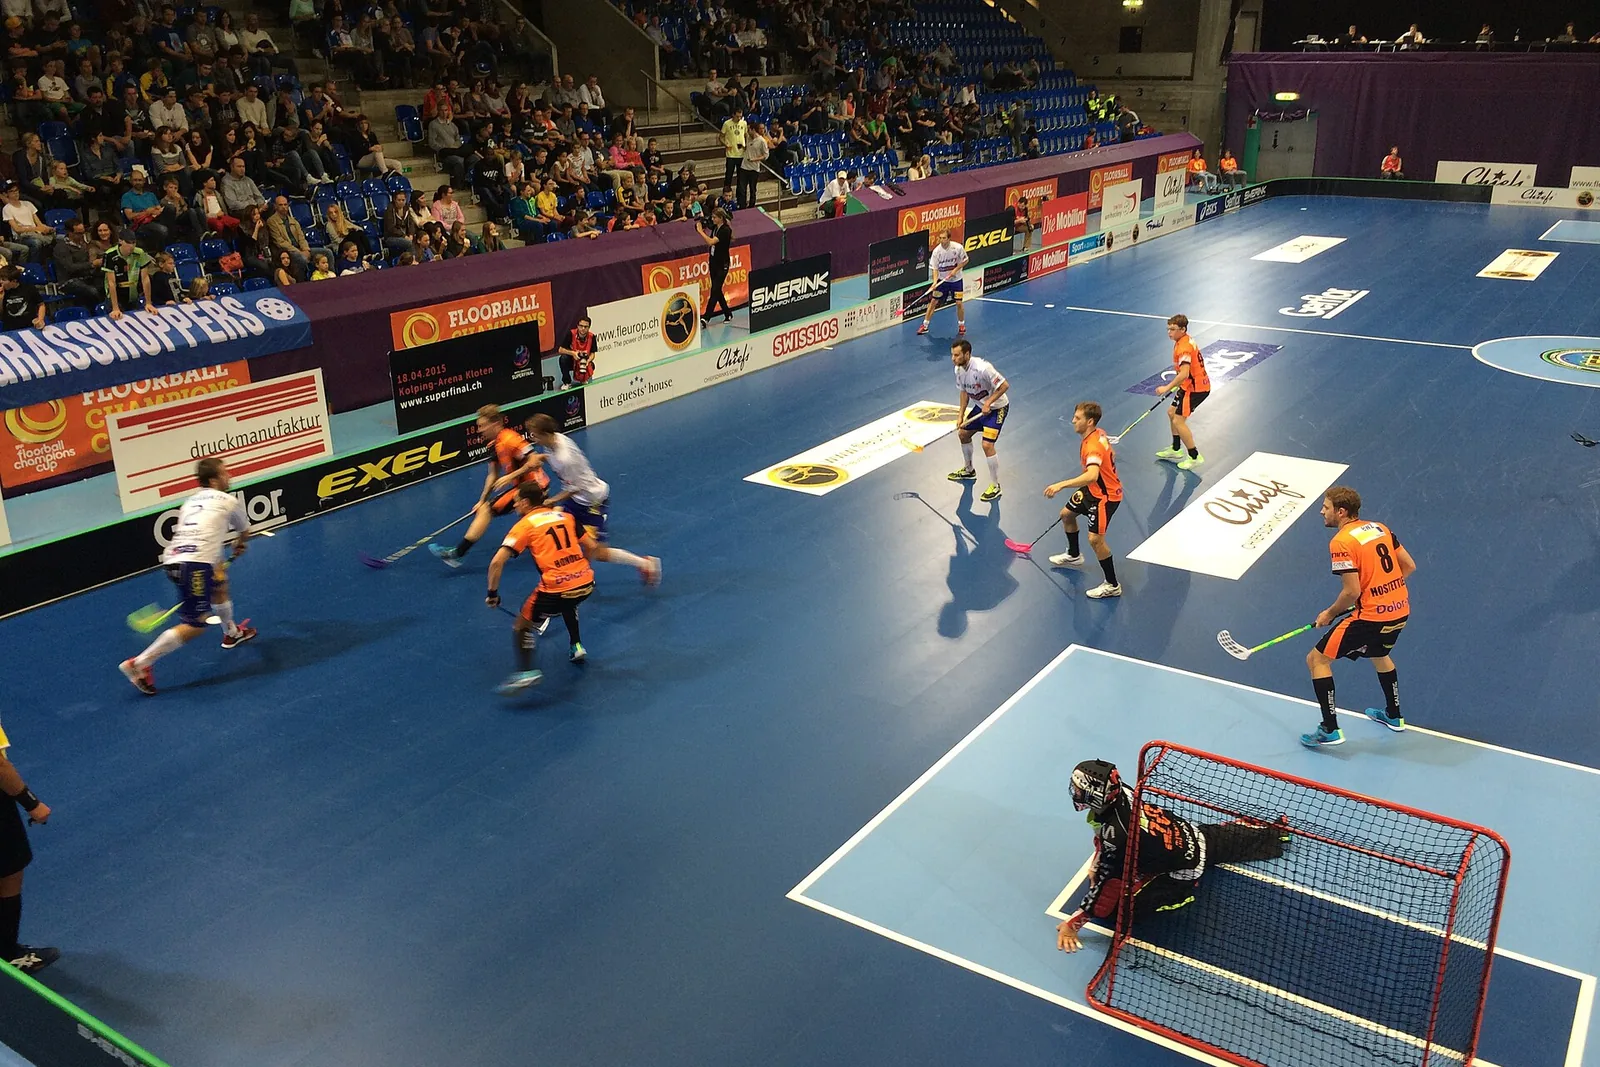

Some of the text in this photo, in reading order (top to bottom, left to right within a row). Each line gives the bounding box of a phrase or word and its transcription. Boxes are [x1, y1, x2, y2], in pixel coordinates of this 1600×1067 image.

[1092, 55, 1100, 66] 5
[1115, 66, 1122, 75] 4
[1136, 87, 1143, 97] 3
[1160, 101, 1167, 112] 2
[1181, 116, 1187, 126] 1
[921, 204, 961, 223] FLOORBALL
[1042, 208, 1087, 235] Die Mobiliar
[964, 227, 1013, 253] EXEL
[1071, 241, 1084, 253] Sport
[1030, 249, 1068, 273] Die Mobiliar
[751, 271, 829, 308] SWERINK
[448, 294, 540, 328] FLOORBALL
[858, 304, 877, 317] PLOT
[773, 317, 839, 357] SWISSLOS
[716, 343, 750, 372] Chiefs
[397, 363, 447, 385] 18.04.2015
[398, 365, 494, 397] Kolping-Arena Kloten
[400, 380, 483, 410] www.superfinal.ch
[600, 395, 615, 409] the
[648, 377, 673, 394] house
[190, 412, 322, 460] druckmanufaktur
[14, 447, 76, 471] champions
[16, 439, 65, 460] floorball
[36, 459, 58, 473] cup
[316, 440, 461, 499] EXEL
[1204, 477, 1306, 526] Chiefs
[546, 523, 571, 551] 17
[1375, 542, 1394, 574] 8
